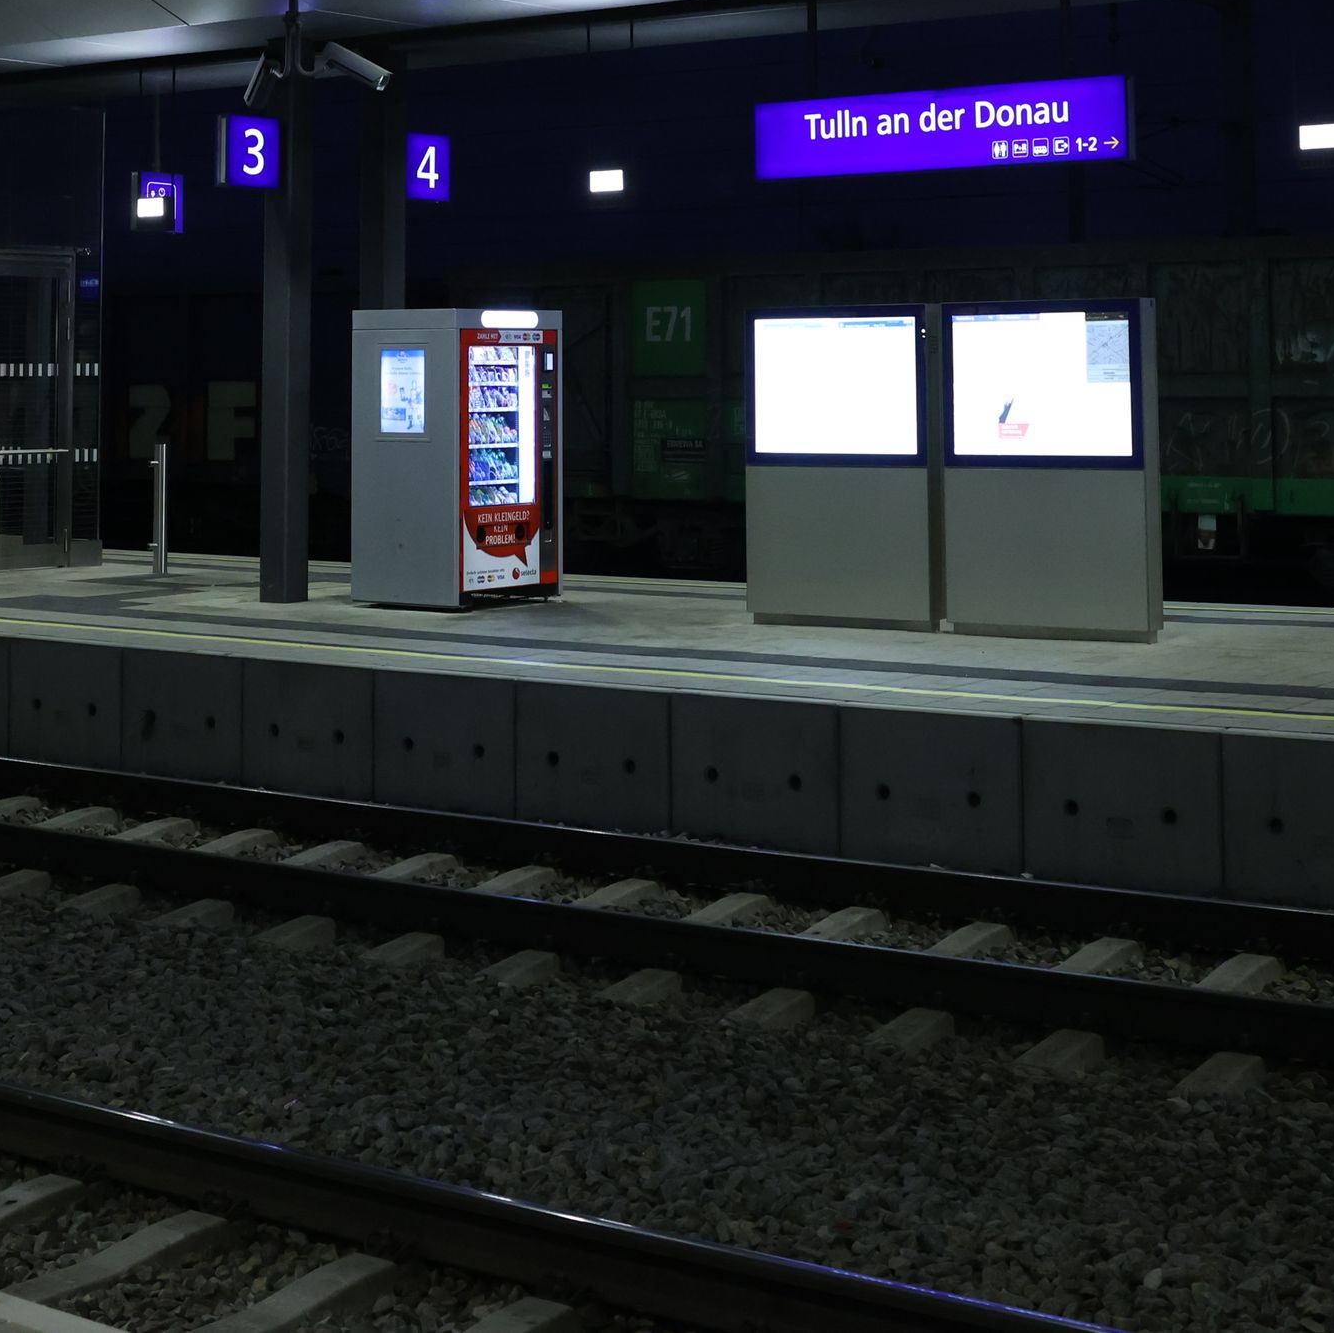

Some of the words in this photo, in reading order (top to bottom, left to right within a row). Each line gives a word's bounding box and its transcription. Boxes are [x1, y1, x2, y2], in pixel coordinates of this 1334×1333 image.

[804, 110, 868, 140] Tulln
[877, 113, 909, 136] an
[919, 102, 966, 132] der
[975, 100, 1070, 129] Donau
[242, 128, 266, 176] 3
[1076, 136, 1098, 153] 1-2
[416, 146, 439, 189] 4
[645, 306, 692, 342] E71
[478, 513, 493, 523] KEIN
[494, 510, 530, 522] KLEINGELD?
[493, 524, 508, 534] KEIN
[485, 534, 516, 545] PROBLEM!
